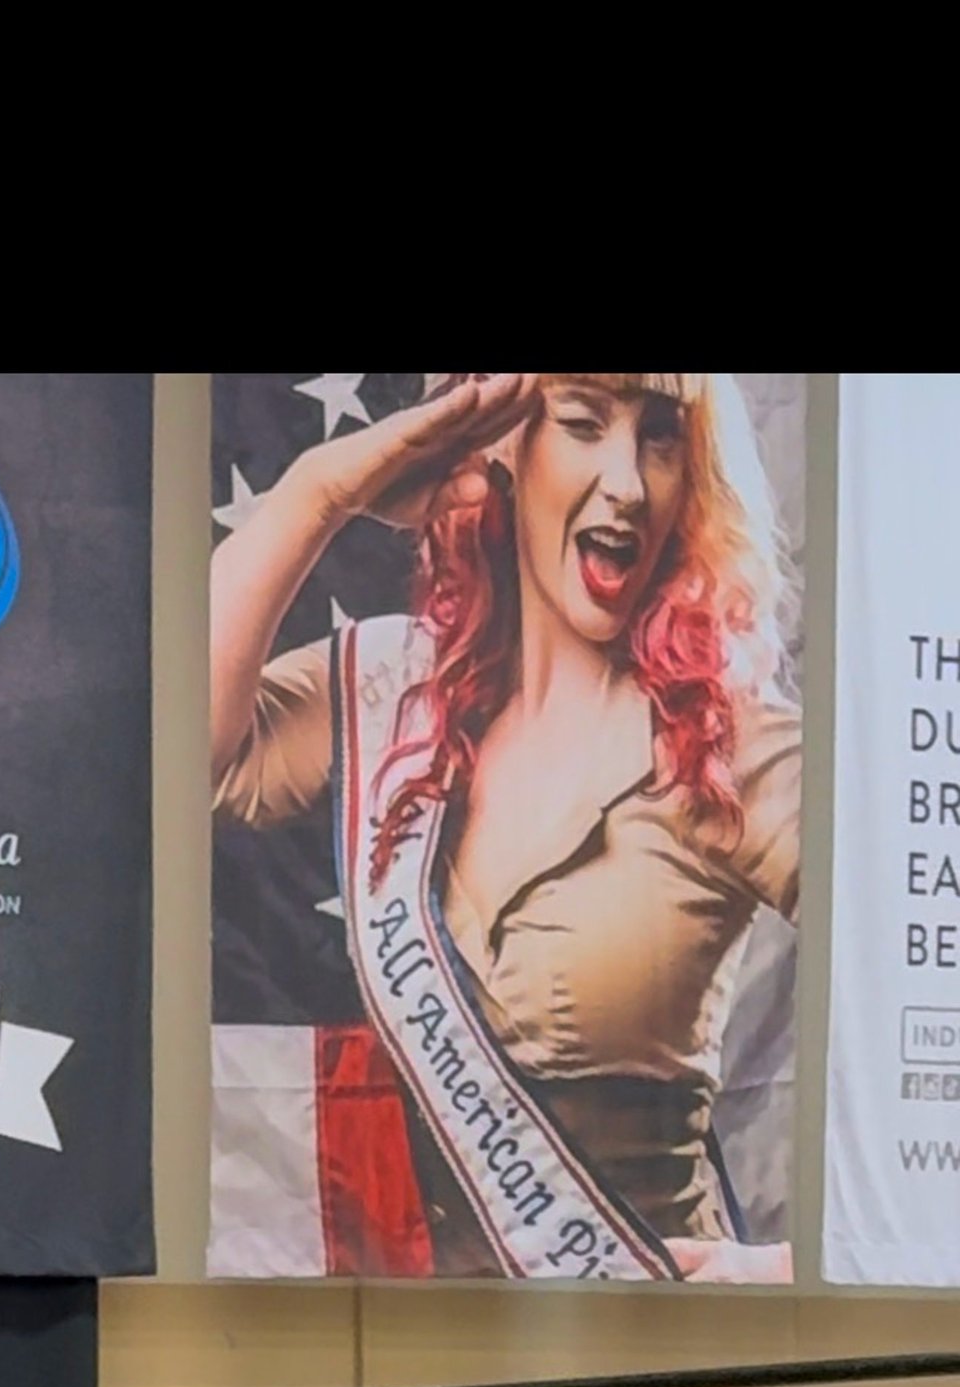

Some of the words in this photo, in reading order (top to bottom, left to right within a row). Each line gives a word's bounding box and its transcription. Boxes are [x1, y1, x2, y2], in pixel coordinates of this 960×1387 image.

[910, 780, 960, 826] BR
[908, 852, 960, 897] EA
[907, 923, 958, 968] BE
[368, 897, 435, 998] All
[406, 993, 556, 1227] American
